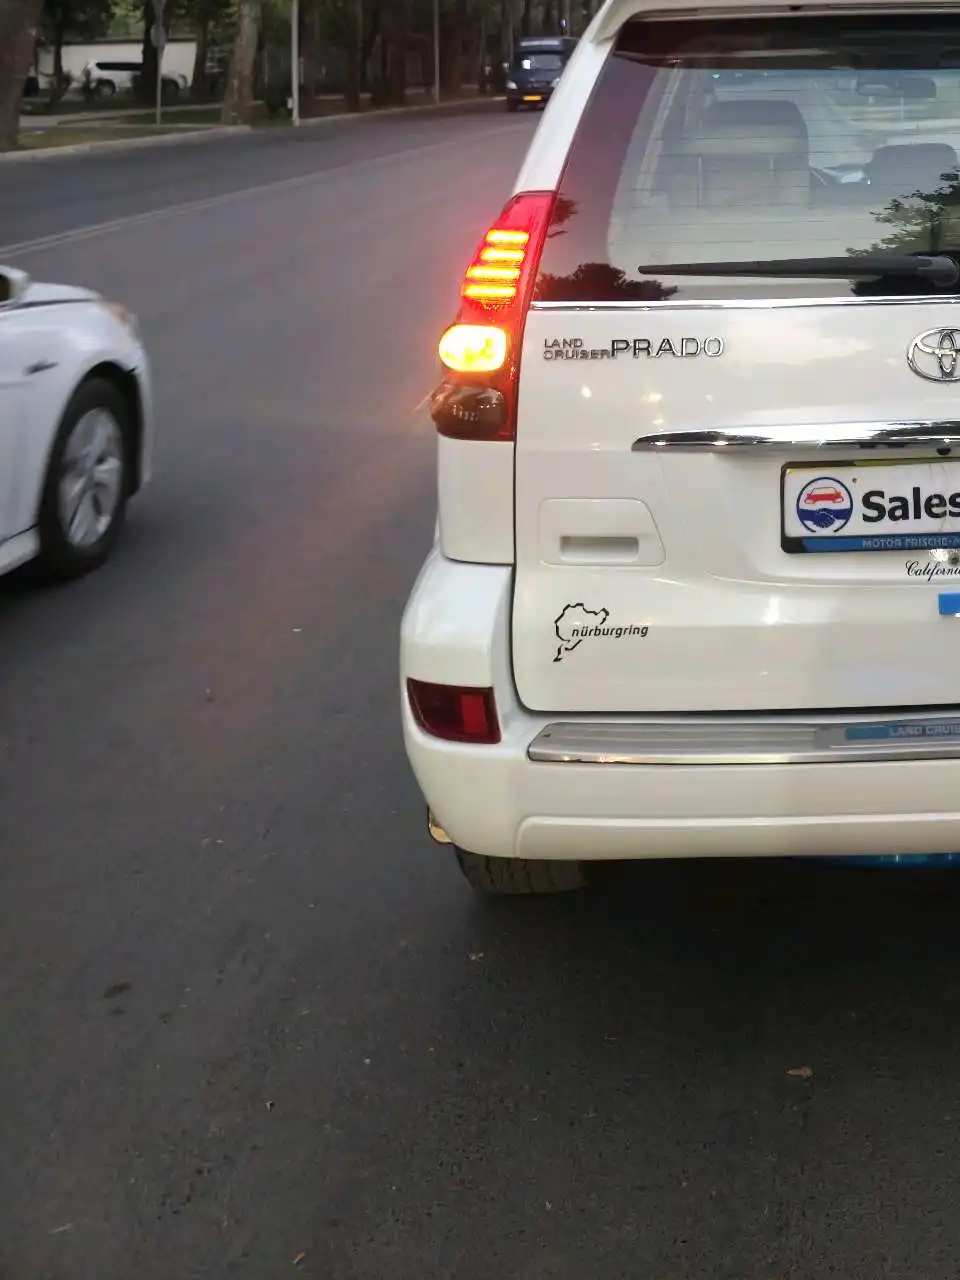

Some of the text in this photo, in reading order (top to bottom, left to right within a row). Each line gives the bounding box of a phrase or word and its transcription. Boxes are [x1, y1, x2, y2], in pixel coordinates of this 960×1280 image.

[543, 336, 725, 361] CRUISER PRADO
[544, 338, 584, 348] LAND
[862, 538, 902, 549] MOTOR
[572, 624, 649, 639] nürburgring
[889, 725, 922, 737] LAND
